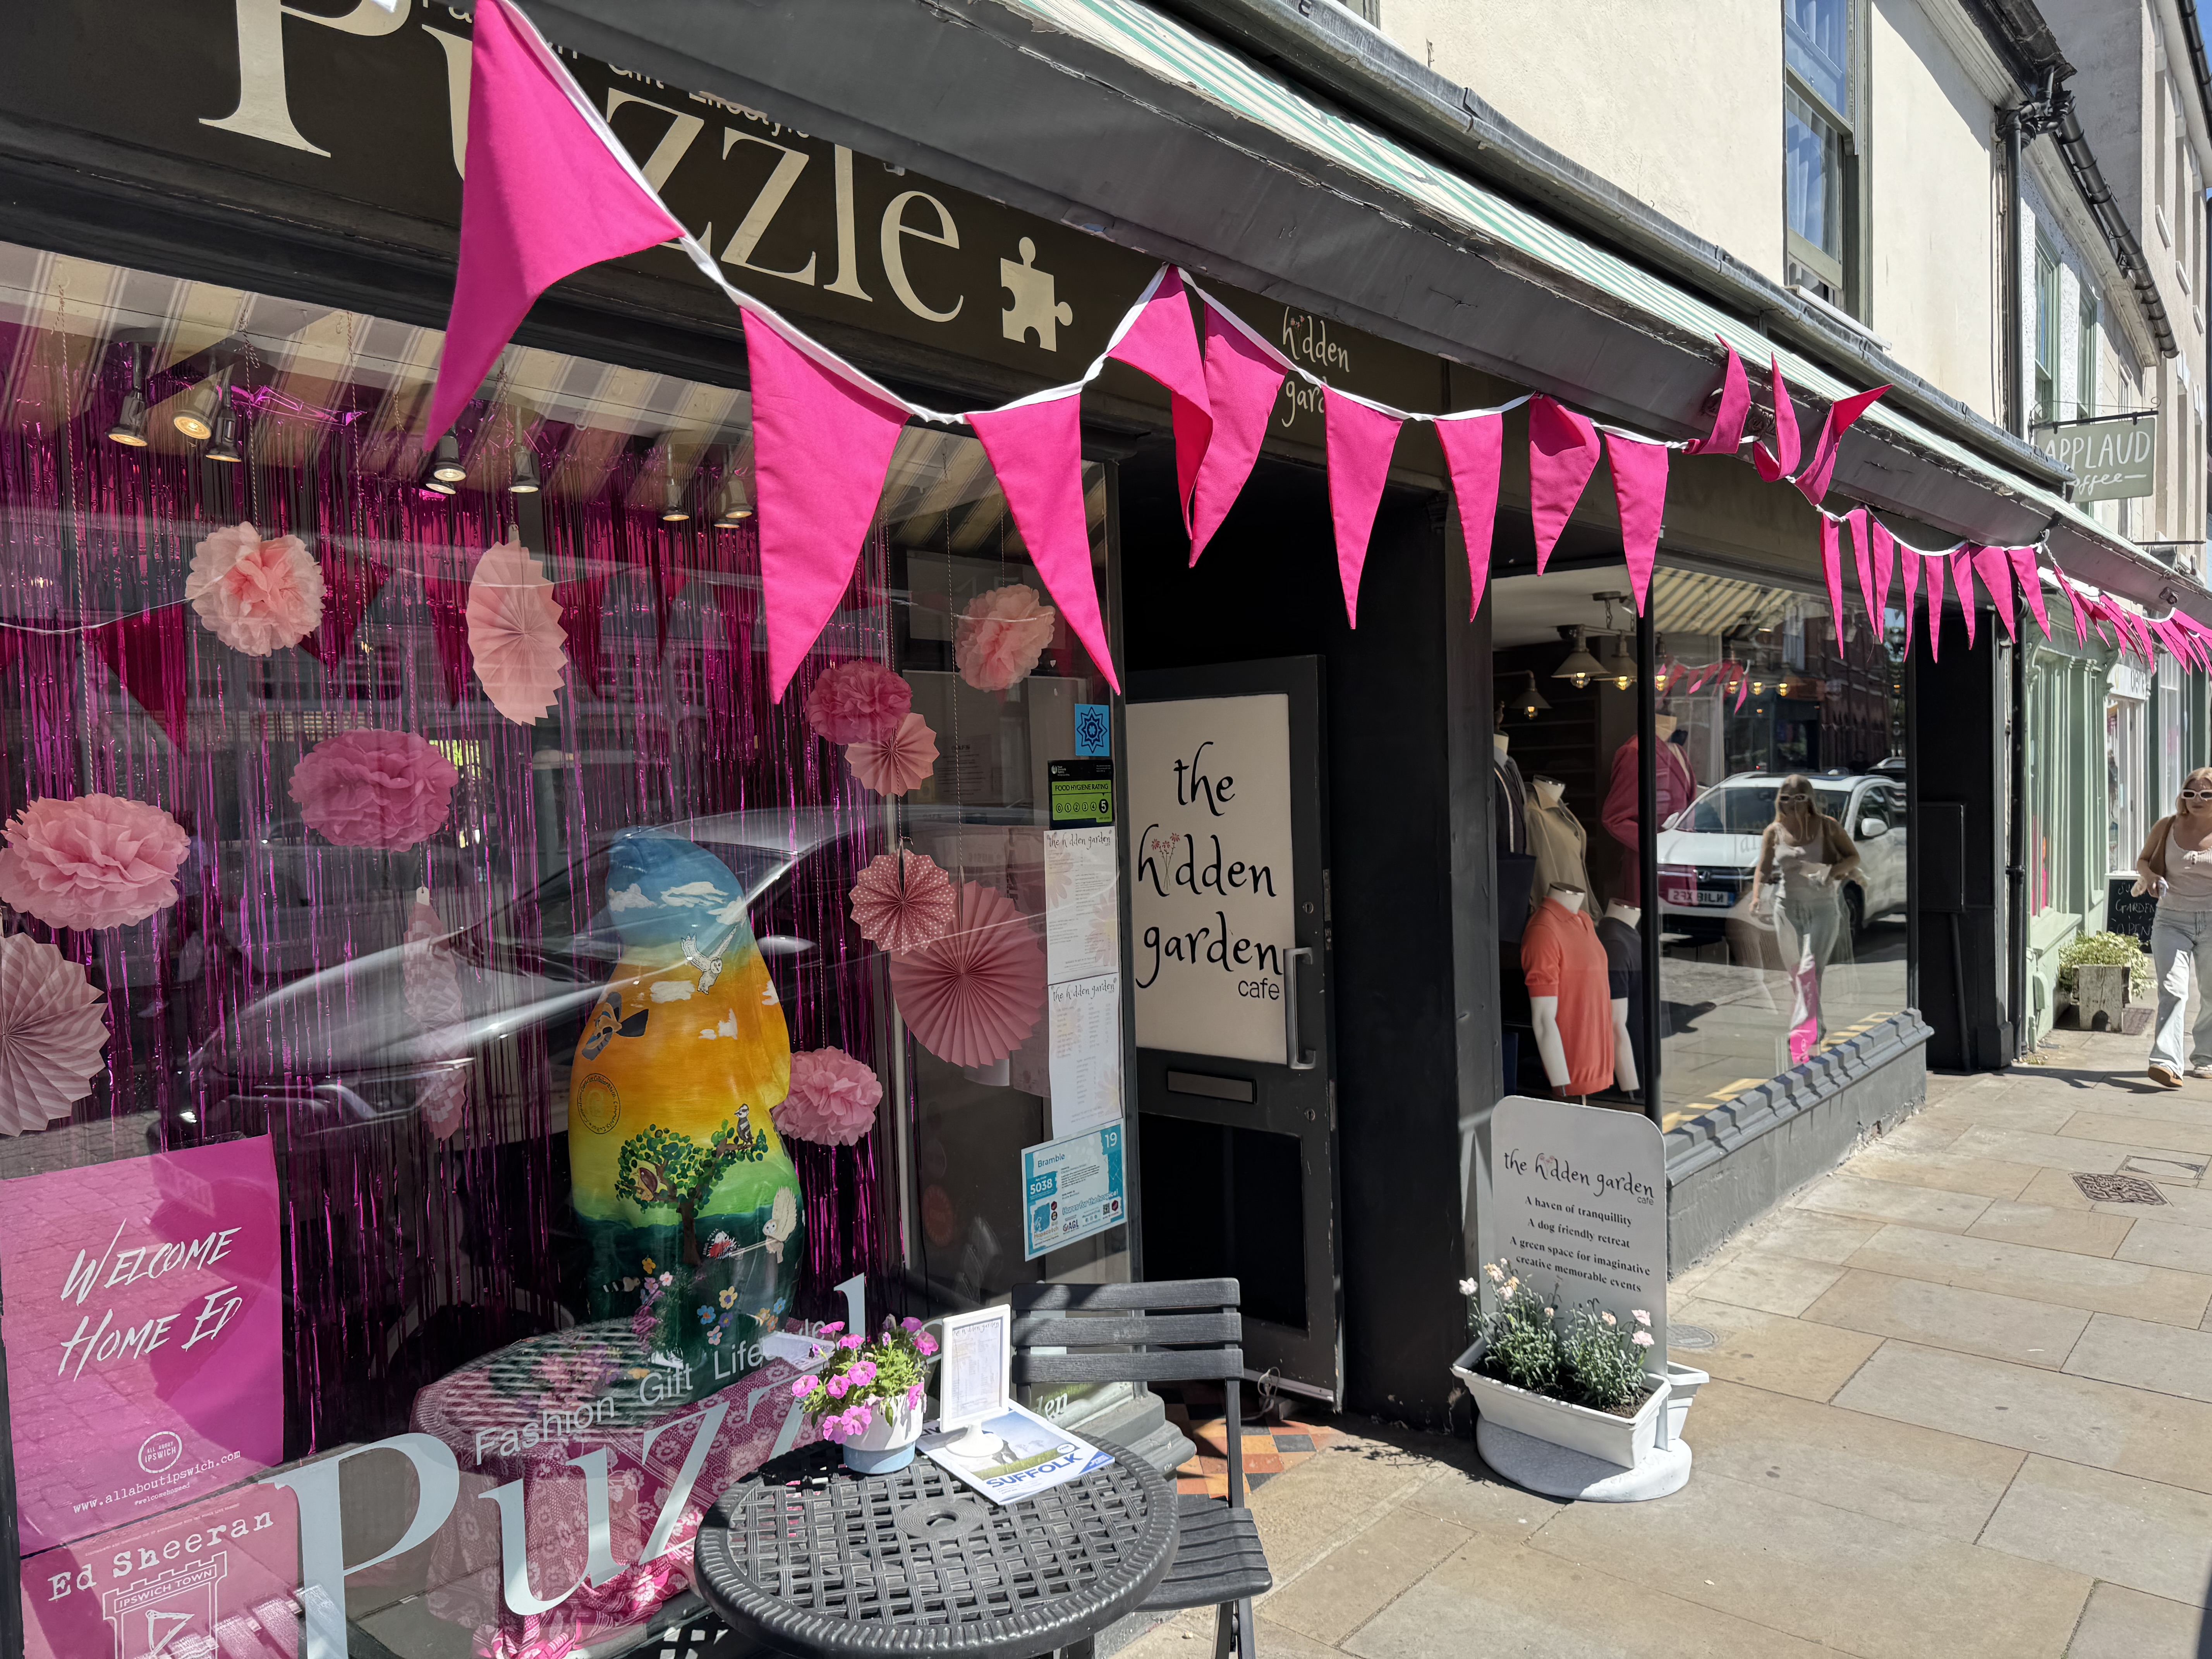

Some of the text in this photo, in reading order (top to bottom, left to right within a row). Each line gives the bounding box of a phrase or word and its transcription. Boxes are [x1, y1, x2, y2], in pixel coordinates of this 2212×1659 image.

[1283, 306, 1350, 373] hidden
[1281, 376, 1327, 428] gar
[2045, 431, 2150, 470] APPLAUD
[2071, 473, 2123, 496] offee
[1173, 741, 1235, 816] the
[1101, 800, 1106, 812] 5
[1049, 832, 1059, 848] the
[1087, 832, 1111, 850] garden
[1138, 824, 1277, 897] hidden
[1135, 911, 1283, 989] garden
[1053, 987, 1063, 1002] the
[1091, 980, 1115, 999] garden
[1238, 979, 1279, 1000] cafe
[1105, 1132, 1118, 1148] 19
[1038, 1153, 1065, 1168] Bramble
[1504, 1149, 1527, 1175] the
[1593, 1172, 1654, 1198] garden
[1030, 1178, 1053, 1195] 5038
[1637, 1196, 1654, 1206] cafe
[1079, 1200, 1088, 1209] for
[1088, 1197, 1097, 1206] the
[1525, 1195, 1632, 1227] A haven of tranquillity
[1068, 1219, 1079, 1230] AGL
[1527, 1218, 1630, 1249] A dog friendly retreat
[1510, 1236, 1650, 1276] A green space for imaginative
[1516, 1255, 1642, 1293] creative memorable events
[475, 1392, 617, 1467] Fashion
[639, 1362, 694, 1407] Gift
[145, 1446, 176, 1463] IPSWICH
[158, 1441, 173, 1450] ABOUT
[73, 1449, 241, 1513] www.allaboutipswich.com
[986, 1453, 1084, 1488] SUFFOLK
[48, 1564, 97, 1602] Ed
[112, 1511, 274, 1579] Sheeran
[119, 1568, 213, 1608] IPSWICH TOWN
